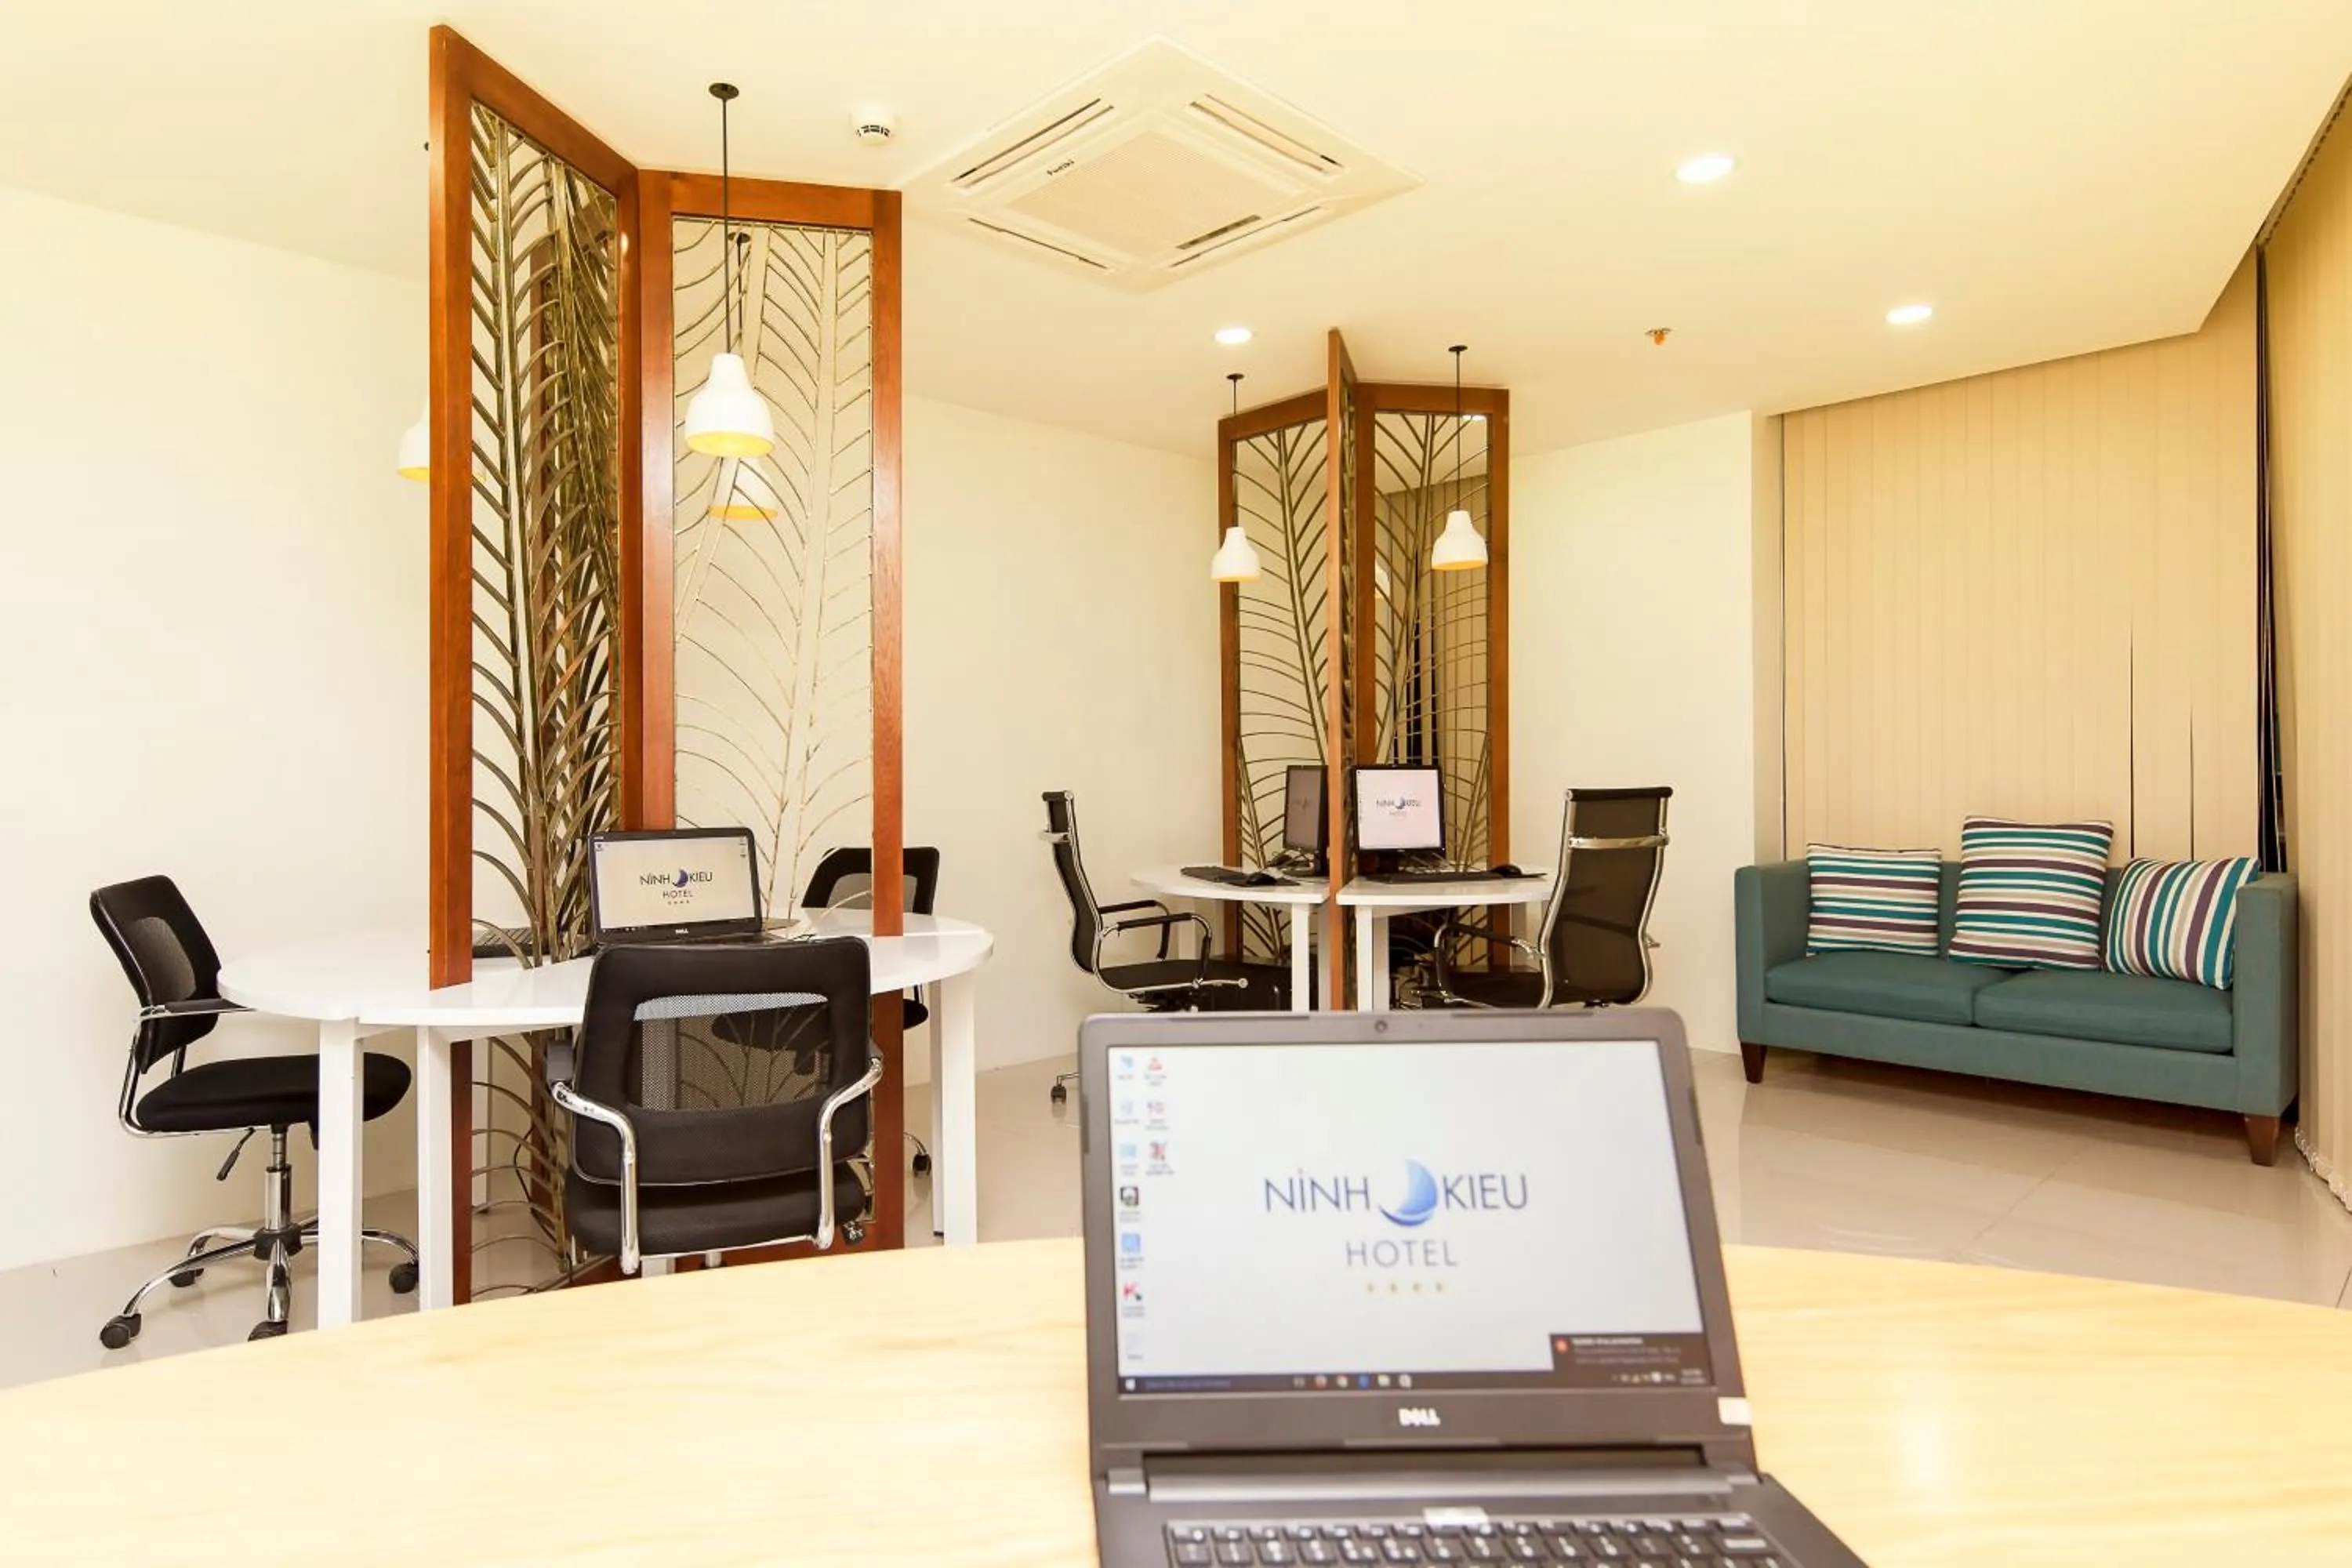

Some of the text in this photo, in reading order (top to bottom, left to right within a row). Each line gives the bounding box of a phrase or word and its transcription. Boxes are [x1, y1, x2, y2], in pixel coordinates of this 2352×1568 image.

[689, 871, 713, 882] KIEU
[662, 889, 694, 898] HOTEL
[1443, 1174, 1528, 1210] KIEU
[1345, 1239, 1459, 1269] HOTEL
